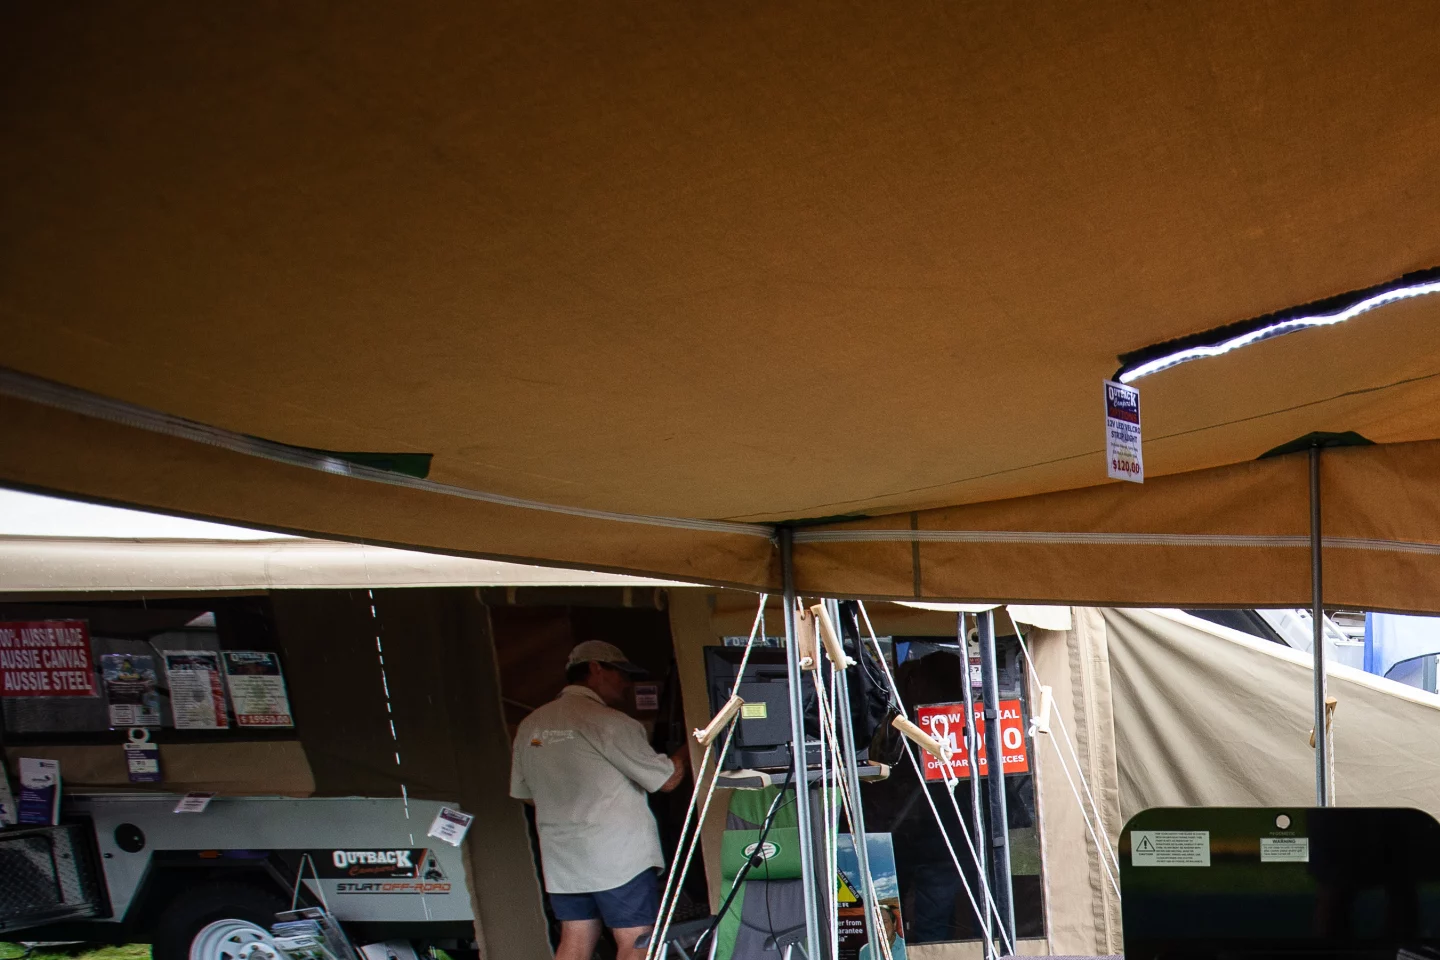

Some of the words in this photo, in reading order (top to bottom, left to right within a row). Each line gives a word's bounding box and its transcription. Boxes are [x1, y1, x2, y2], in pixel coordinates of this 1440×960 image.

[1108, 386, 1136, 407] OUTBACK
[1111, 431, 1124, 439] STRIP
[1125, 433, 1137, 443] LIGHT
[1116, 422, 1124, 430] LED
[1124, 423, 1140, 434] VELCRO
[1113, 460, 1139, 474] $120.00
[0, 629, 20, 647] 00%
[20, 628, 56, 647] AUSSIE
[56, 628, 85, 646] MADE
[1, 649, 41, 669] AUSSIE
[43, 650, 88, 668] CANVAS
[4, 671, 51, 691] AUSSIE
[52, 672, 92, 690] STEEL
[333, 850, 413, 868] OUTBACK
